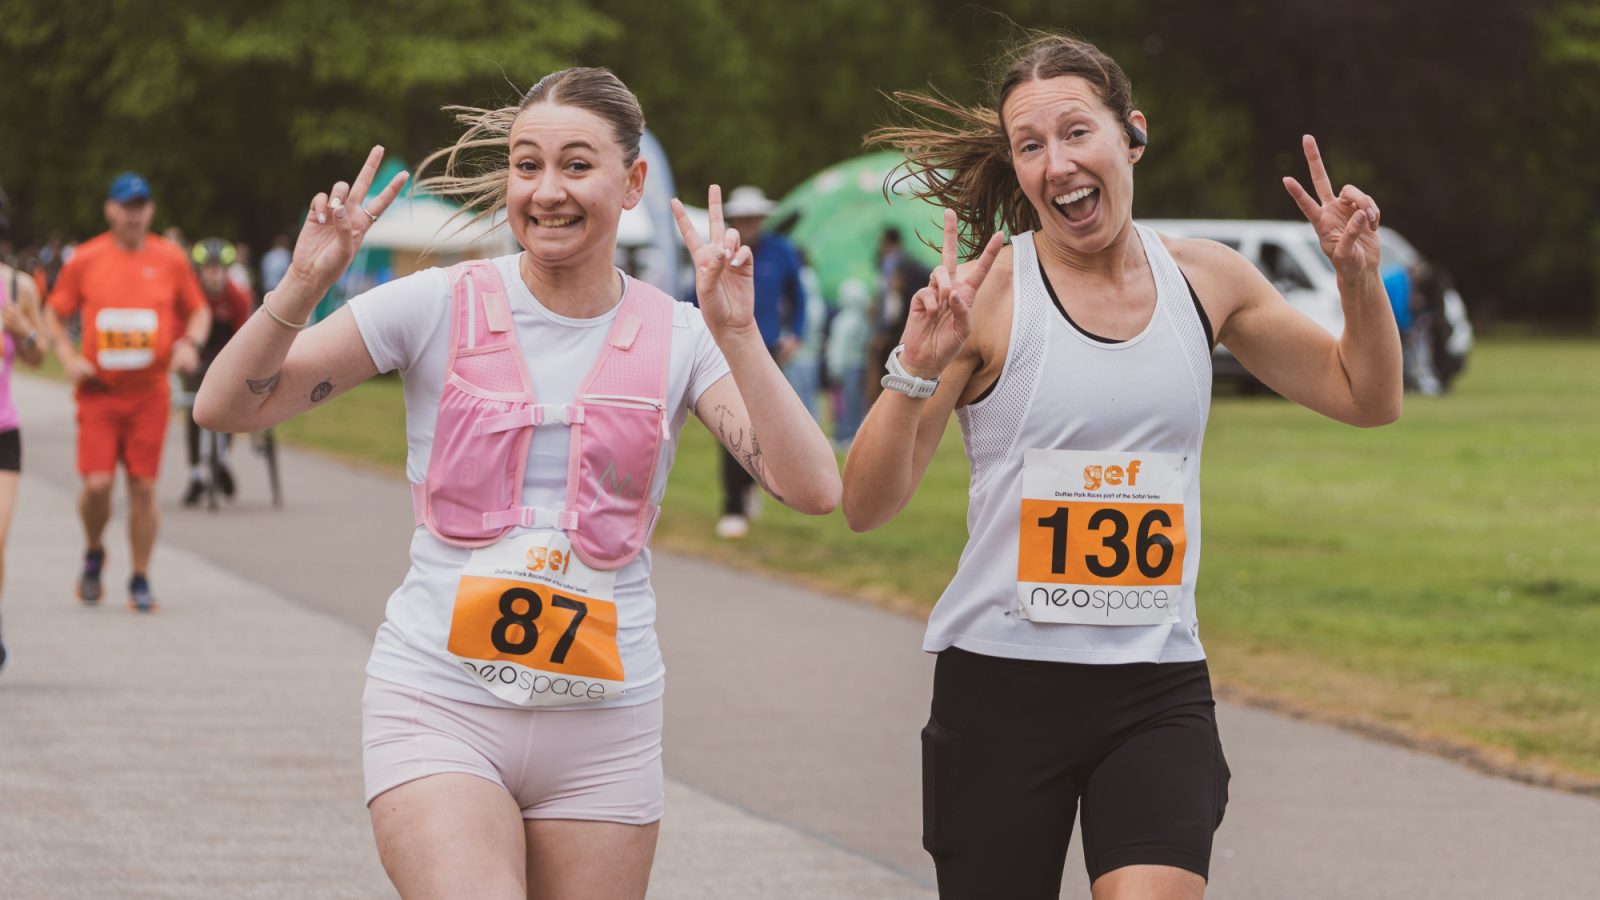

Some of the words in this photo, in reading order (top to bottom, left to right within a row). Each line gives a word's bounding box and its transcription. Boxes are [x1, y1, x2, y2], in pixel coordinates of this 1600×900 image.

[1083, 459, 1142, 491] gef
[1054, 490, 1073, 498] Duthie
[1073, 491, 1086, 499] Park
[1087, 491, 1103, 499] Races
[1103, 492, 1115, 500] part
[1122, 492, 1131, 500] the
[1132, 492, 1147, 500] Safari
[1038, 506, 1175, 579] 136
[1031, 587, 1168, 617] neospace
[491, 587, 588, 665] 87
